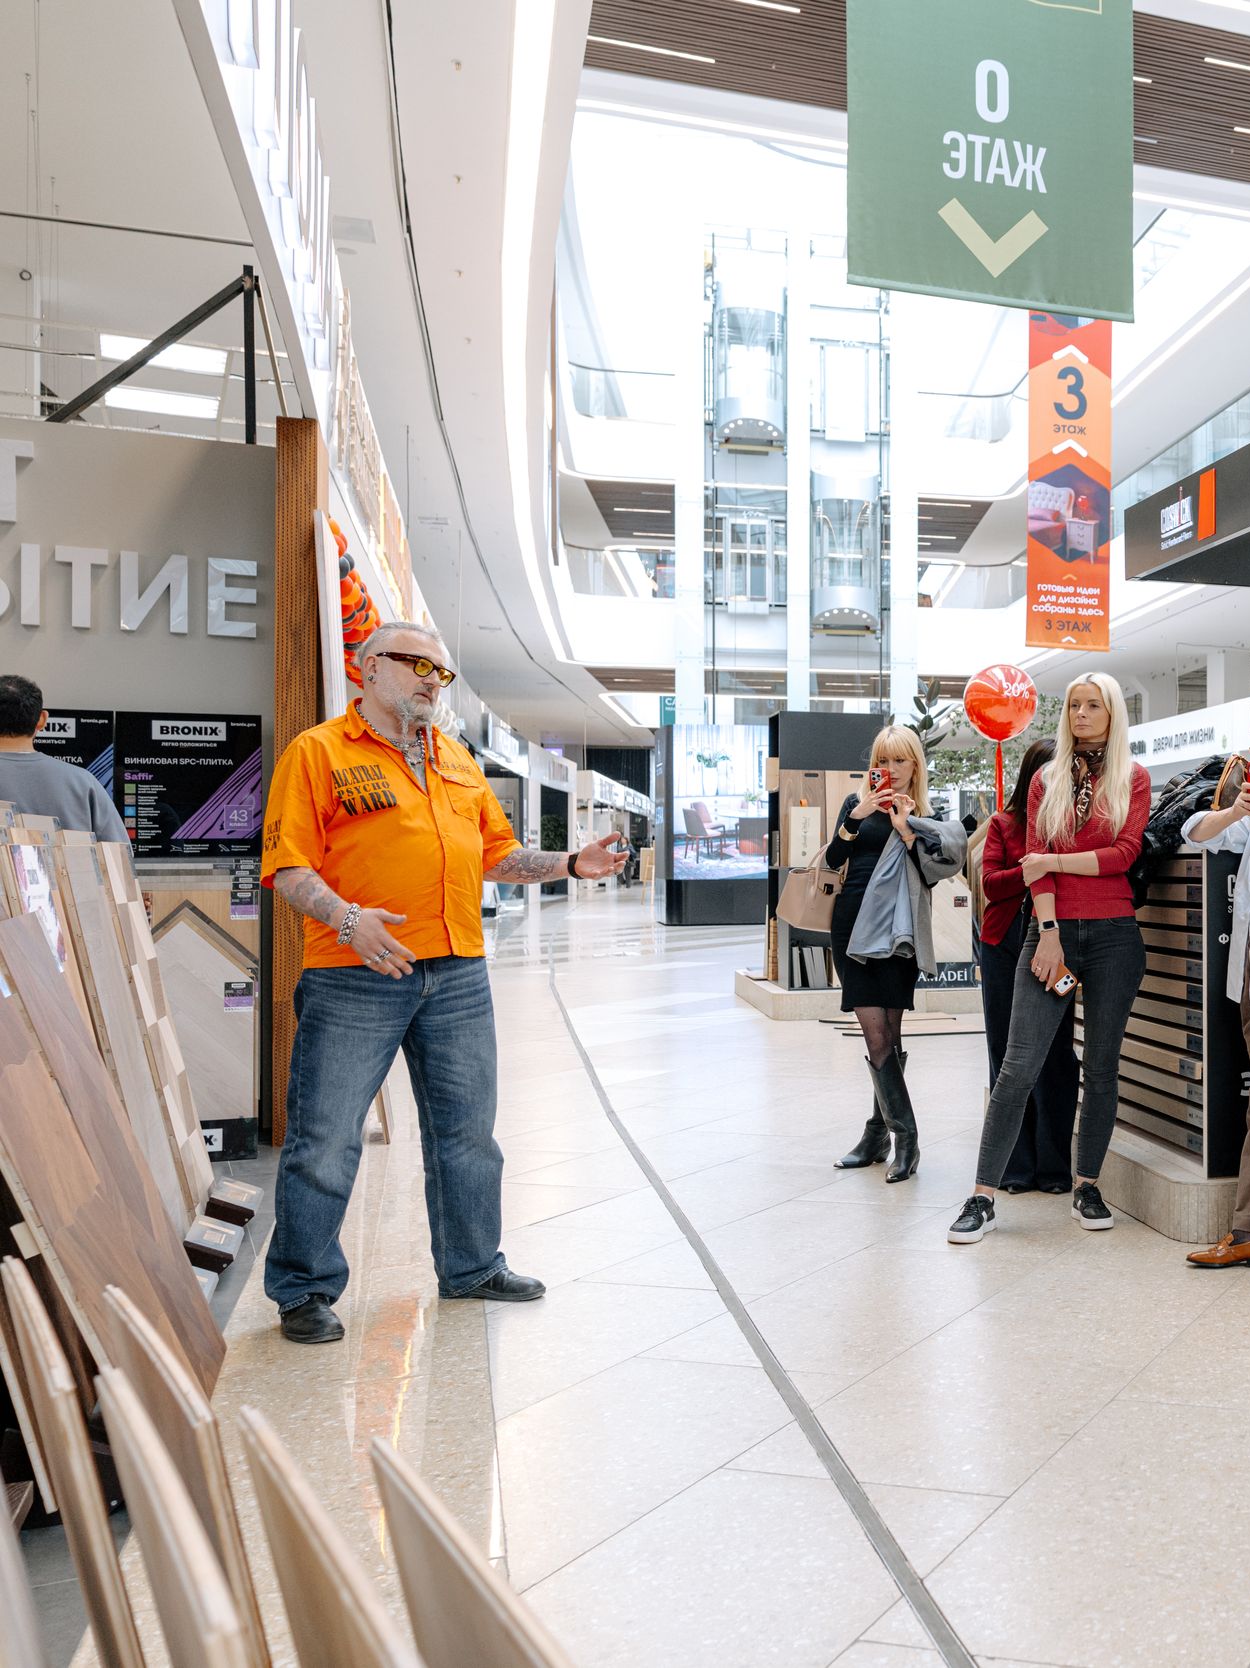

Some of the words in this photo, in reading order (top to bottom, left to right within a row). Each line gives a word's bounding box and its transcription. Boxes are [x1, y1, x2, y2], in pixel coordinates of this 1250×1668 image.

[975, 59, 1009, 123] 0
[942, 130, 1048, 194] ЭТАЖ
[1053, 366, 1087, 420] 3
[1053, 423, 1087, 435] этаж
[1056, 620, 1092, 633] ЭТАЖ
[124, 757, 178, 765] ВИНИЛОВАЯ
[124, 772, 154, 780] Saffir
[331, 764, 386, 789] ALCATRAZ
[337, 781, 390, 798] PSYCHO
[341, 790, 397, 816] WARD
[229, 809, 248, 822] 43
